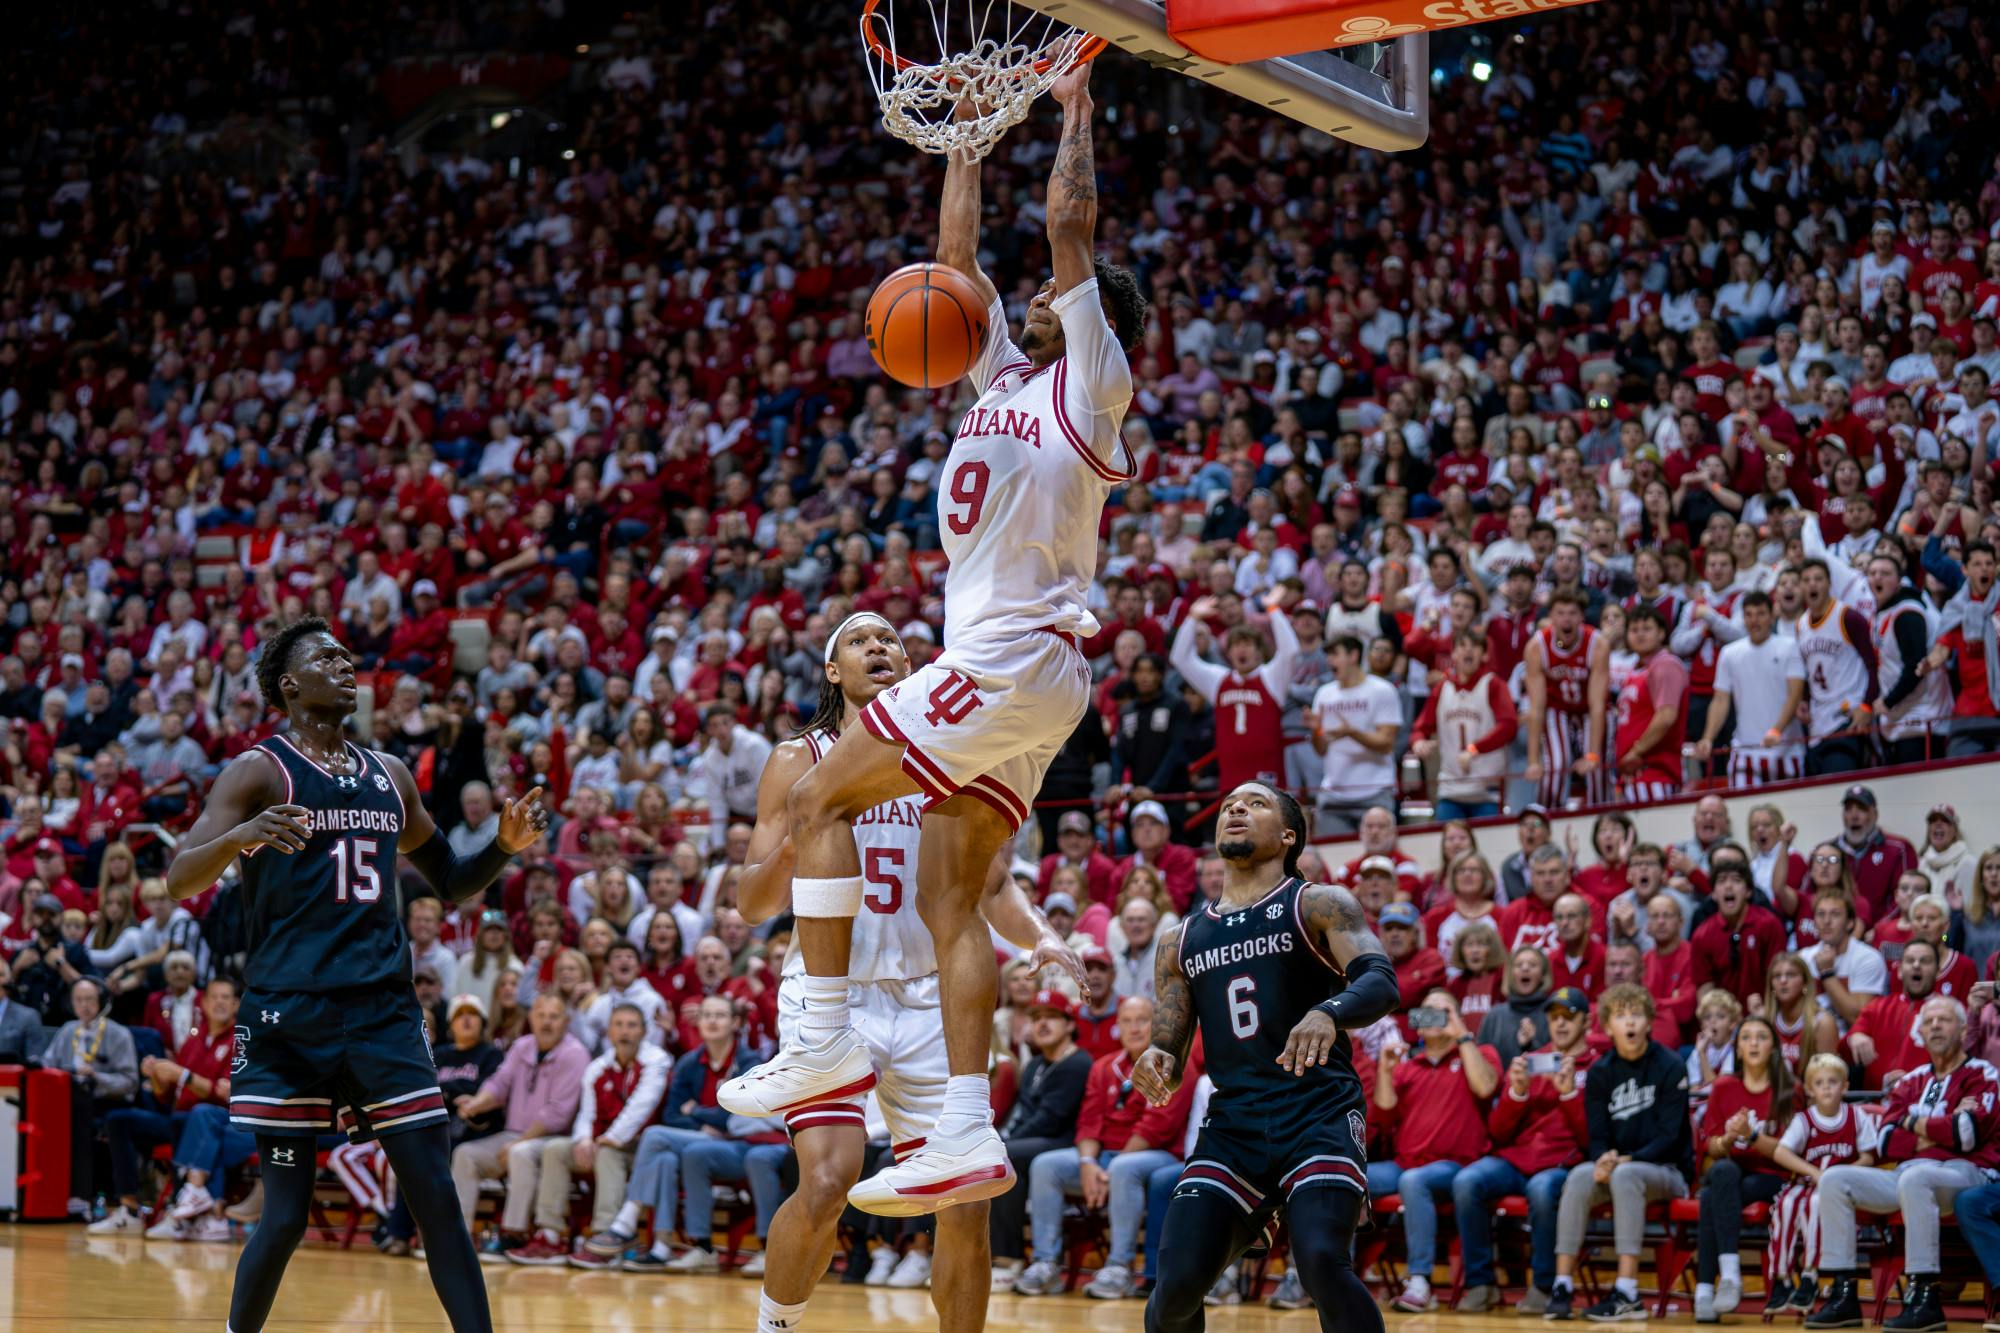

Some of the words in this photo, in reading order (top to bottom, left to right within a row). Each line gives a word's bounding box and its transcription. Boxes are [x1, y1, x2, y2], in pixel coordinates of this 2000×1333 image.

[1423, 0, 1584, 26] Sta
[954, 408, 1041, 449] DIANA
[948, 460, 991, 535] 9
[1812, 662, 1827, 690] 4
[1234, 703, 1247, 734] 1
[307, 809, 399, 833] GAMECOCKS
[852, 799, 922, 830] DIAN
[330, 837, 381, 903] 15
[864, 847, 905, 914] 5
[1265, 903, 1284, 920] SEC
[1184, 932, 1294, 978] GAMECOCKS
[1227, 974, 1259, 1041] 6
